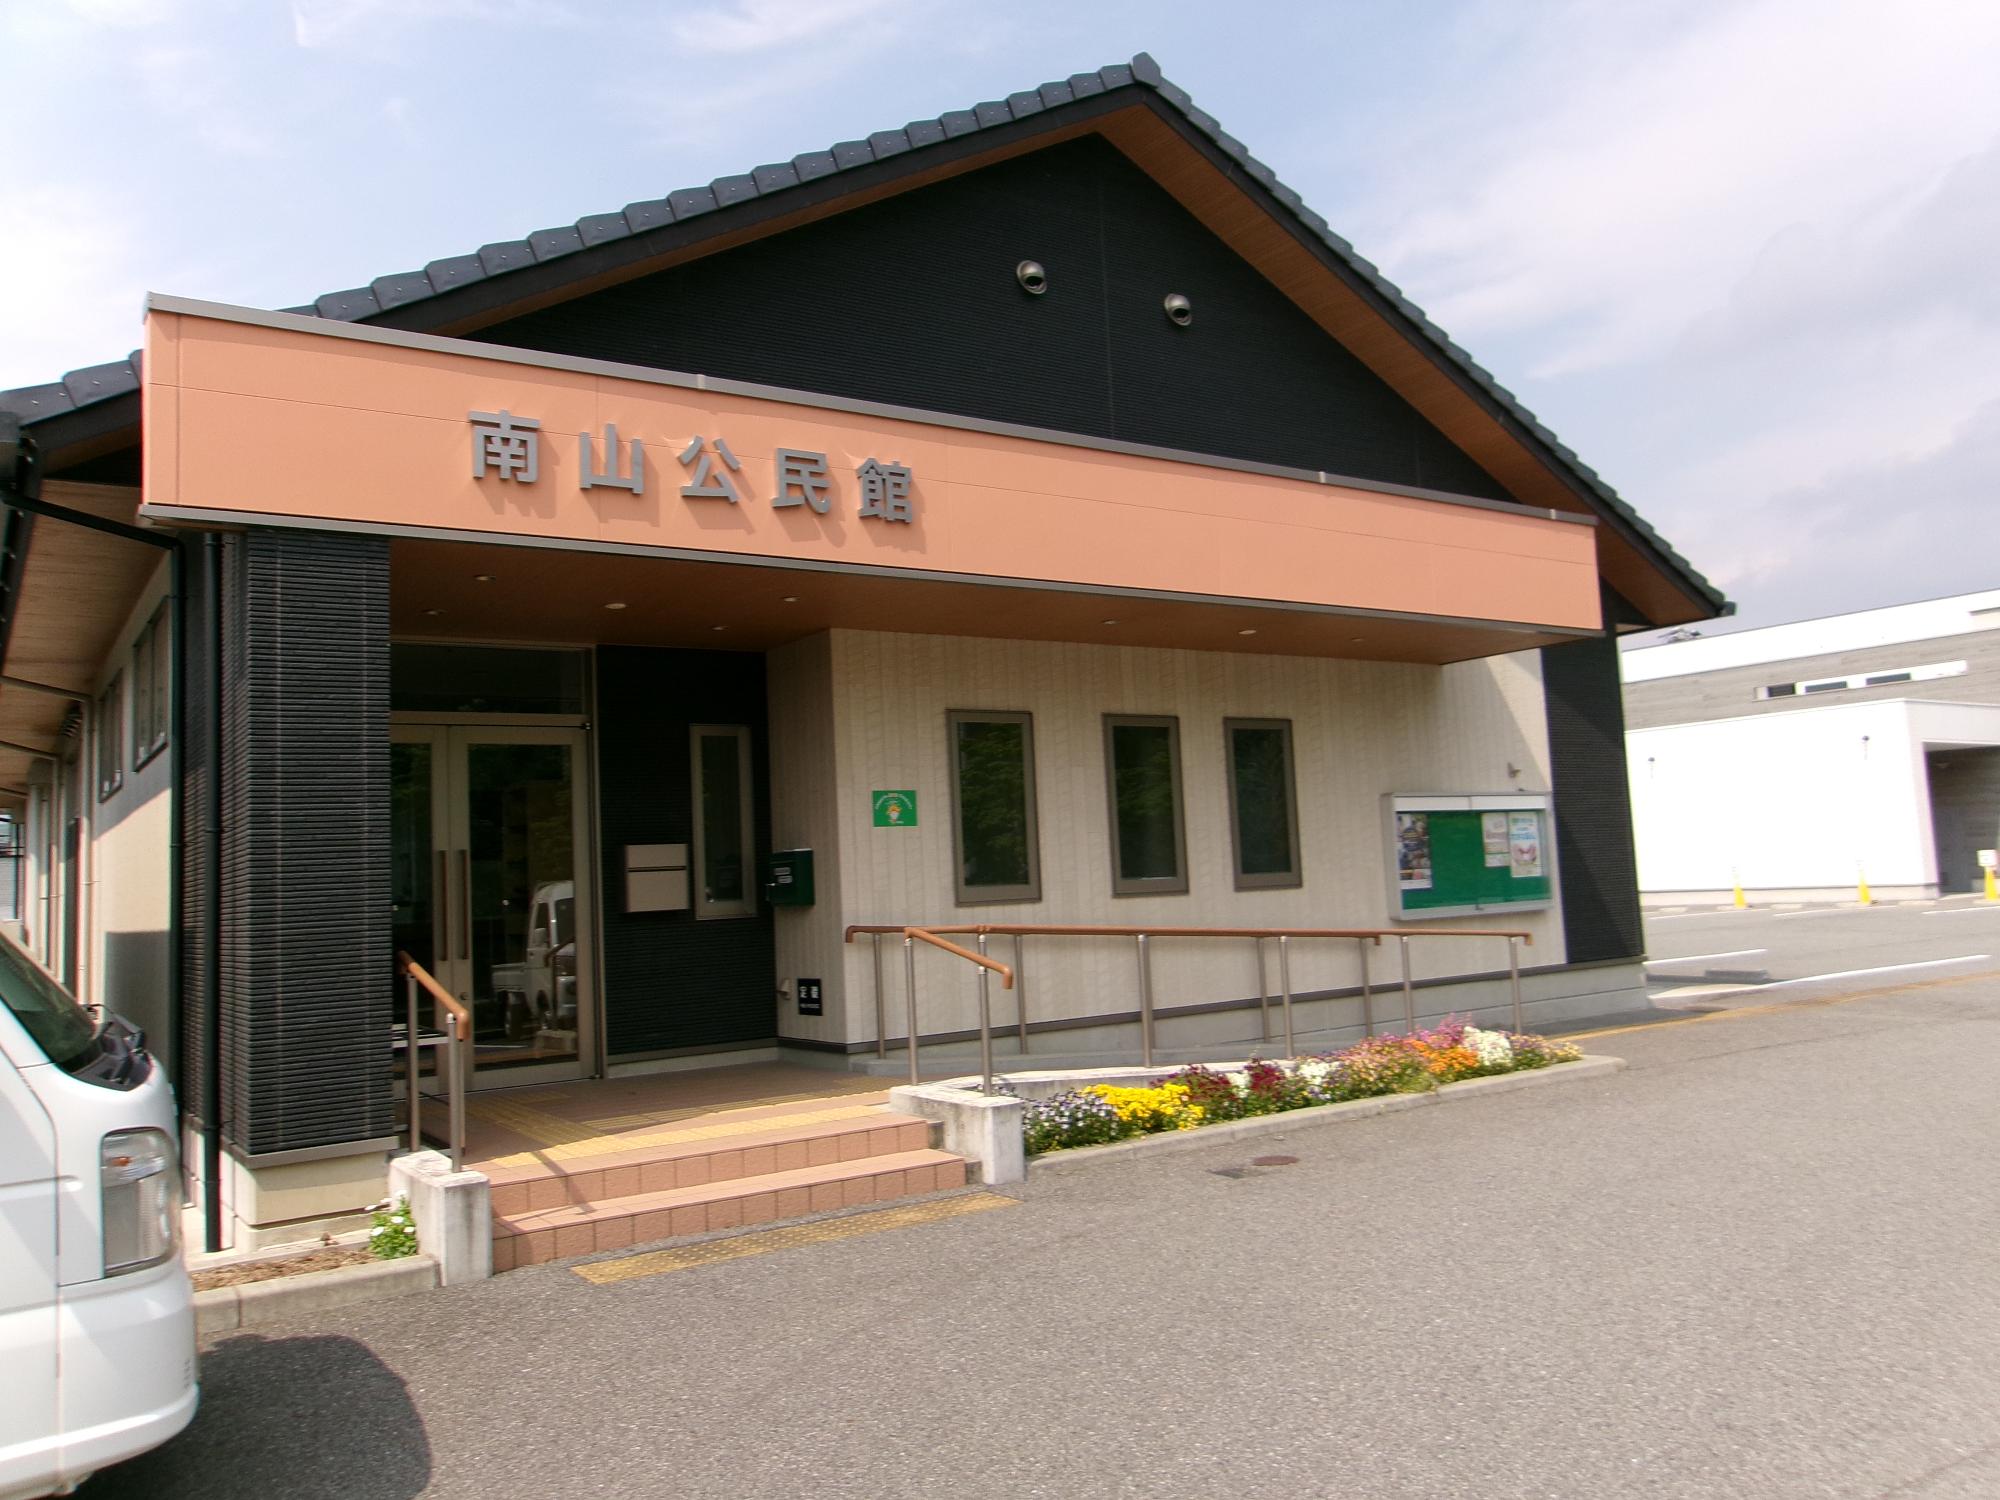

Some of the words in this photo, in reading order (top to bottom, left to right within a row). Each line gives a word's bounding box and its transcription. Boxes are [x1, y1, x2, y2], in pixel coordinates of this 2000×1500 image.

[468, 410, 913, 523] 南山公民館
